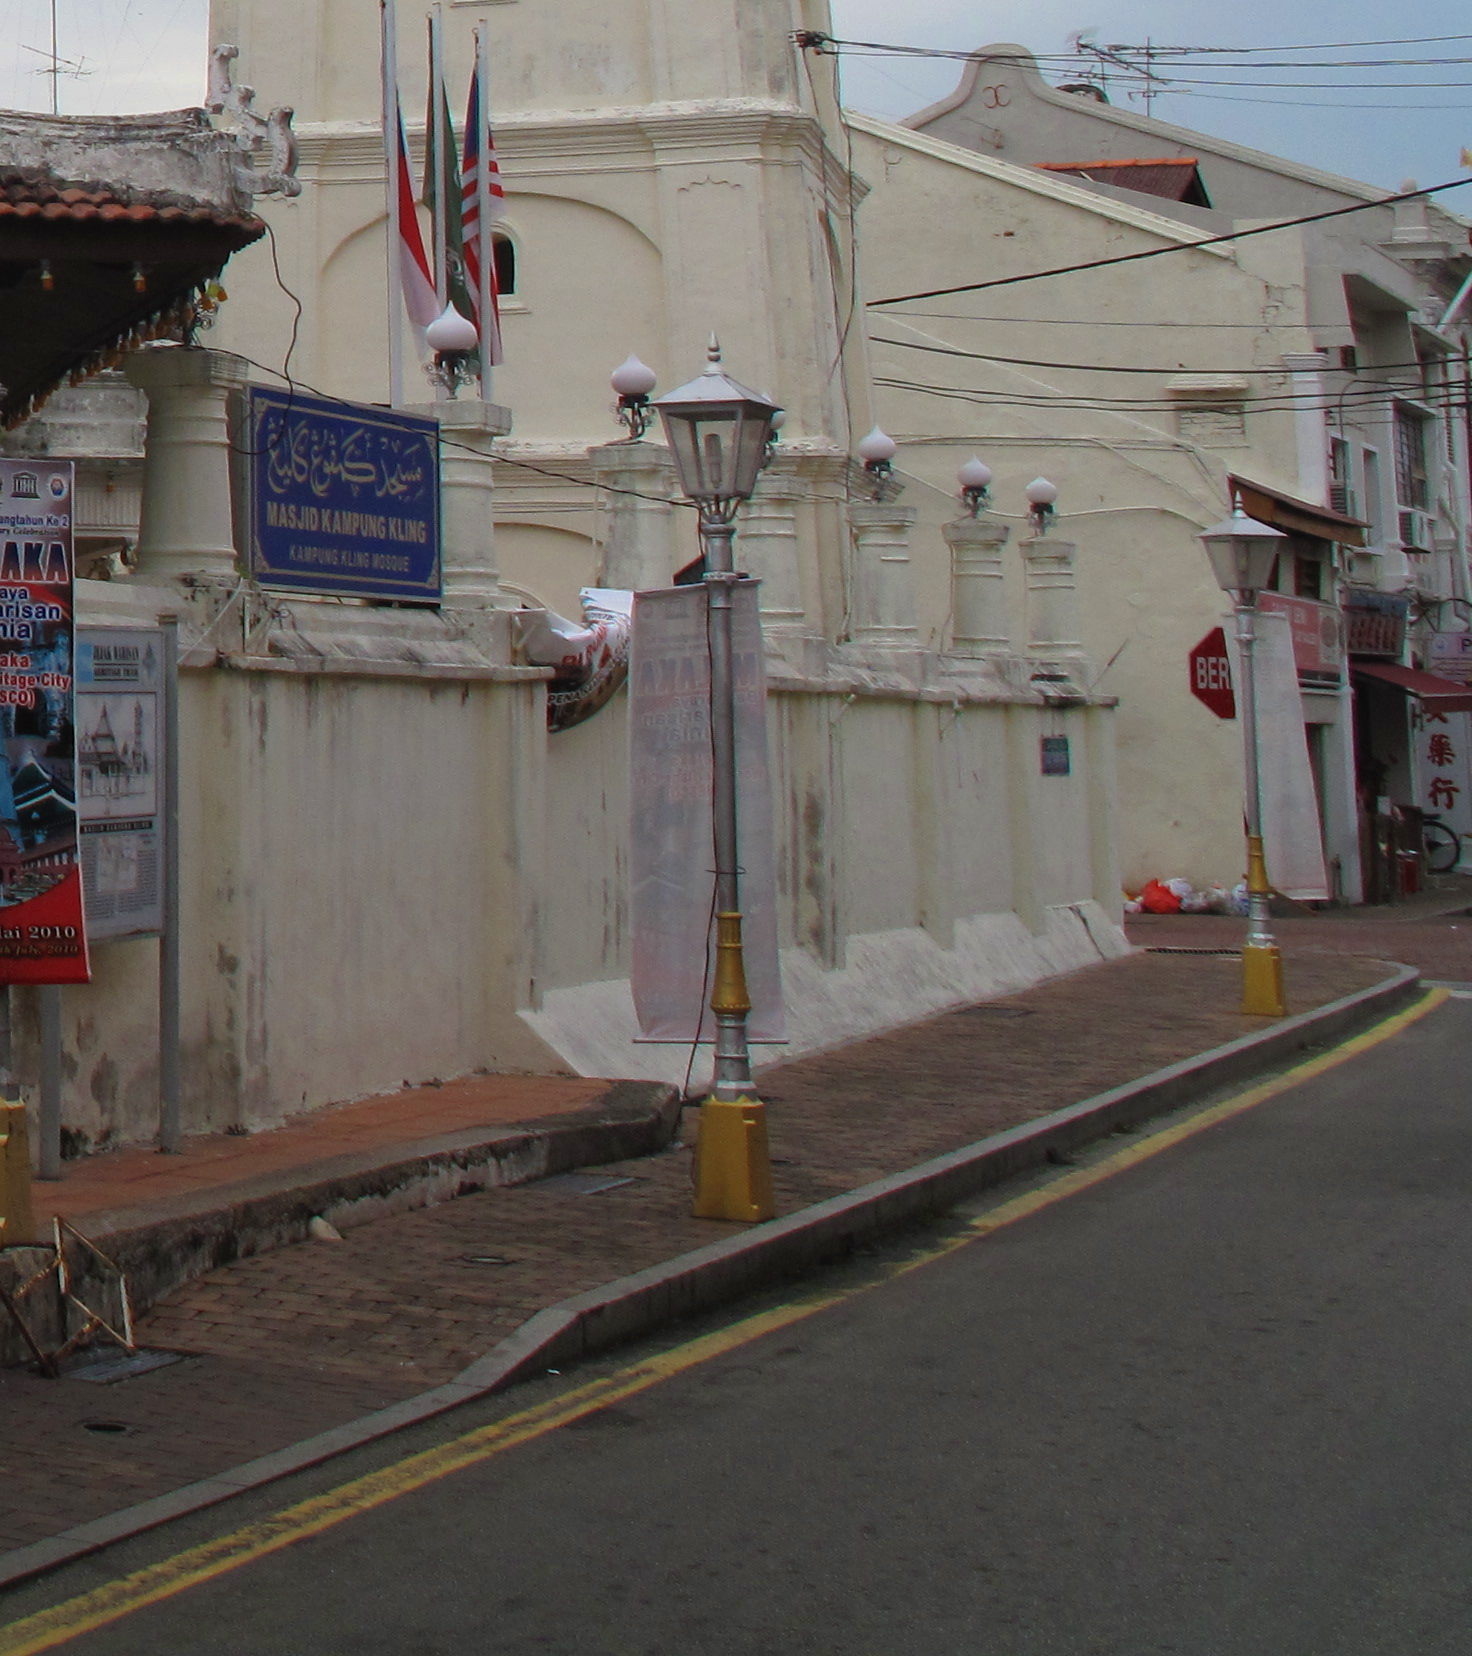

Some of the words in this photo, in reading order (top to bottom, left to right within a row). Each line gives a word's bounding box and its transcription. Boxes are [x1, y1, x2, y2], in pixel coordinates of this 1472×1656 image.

[46, 515, 59, 526] Ke
[61, 515, 69, 527] 2
[266, 501, 319, 531] MASJID
[321, 510, 387, 539] KAMPUNG
[389, 517, 427, 544] KLING
[12, 527, 60, 537] Celebration
[289, 545, 339, 565] KAMPUNG
[340, 549, 370, 568] KLING
[372, 554, 411, 573] MOSQUE
[40, 672, 71, 690] City
[29, 925, 76, 940] 2010
